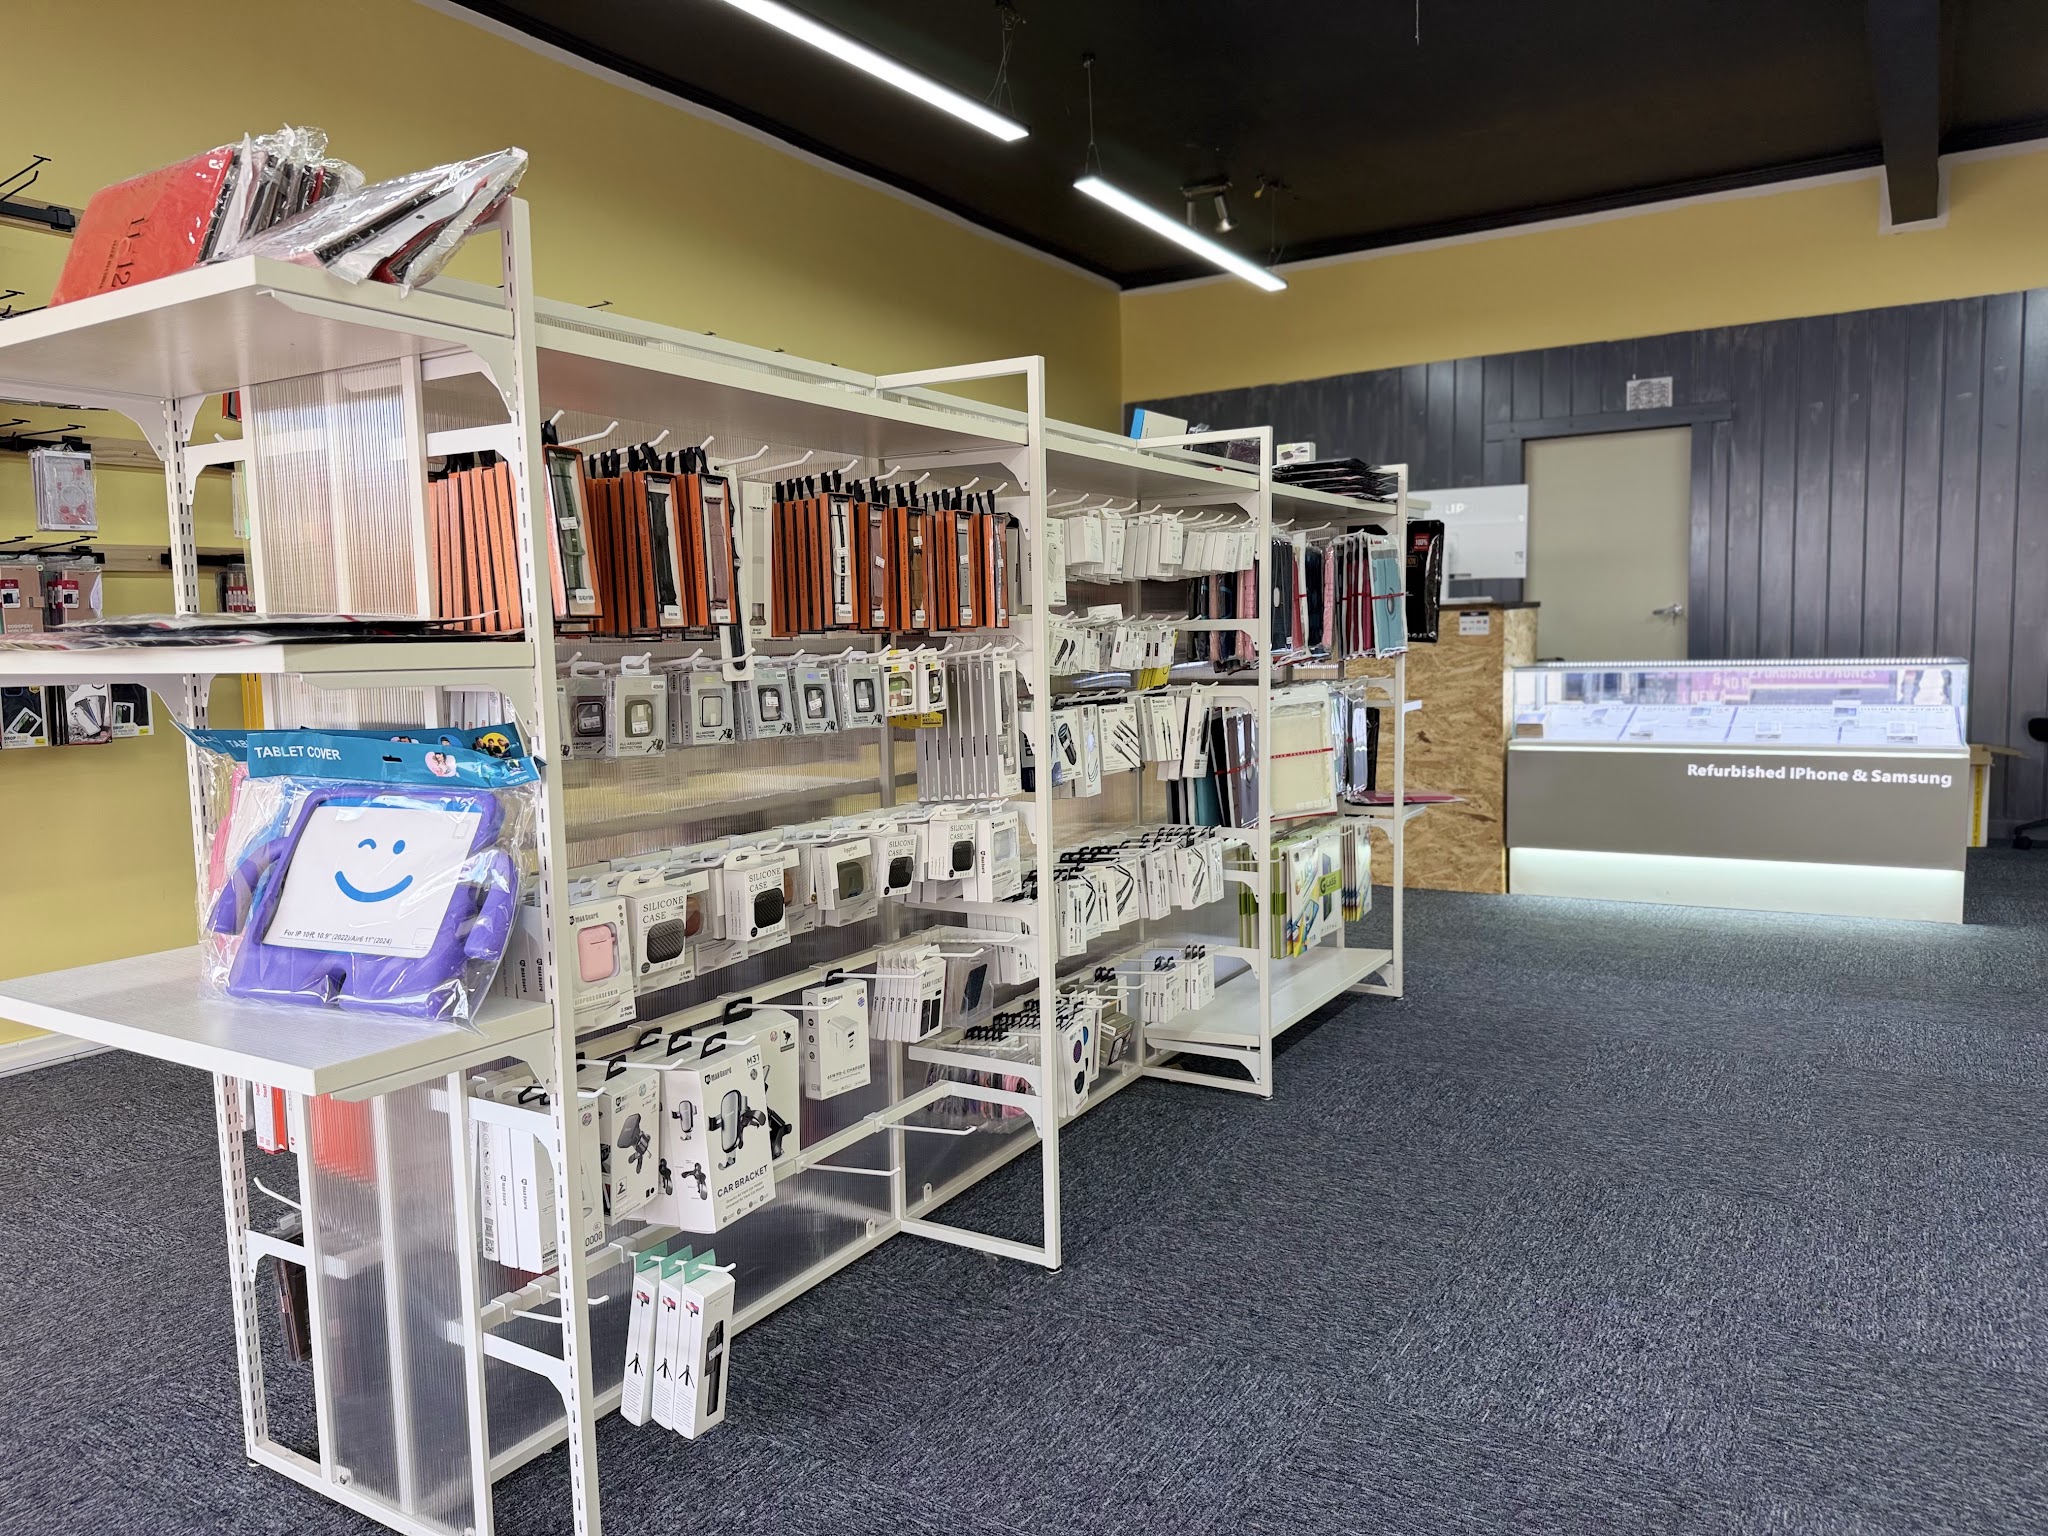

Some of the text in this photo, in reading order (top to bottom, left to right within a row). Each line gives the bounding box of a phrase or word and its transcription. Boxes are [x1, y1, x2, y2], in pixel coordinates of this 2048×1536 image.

[254, 746, 341, 761] TABLET COVER
[1687, 763, 1953, 788] Refurbished IPhone & Samsung
[950, 824, 974, 832] SILICONE
[950, 832, 963, 840] CASE
[888, 839, 914, 849] SILICONE
[888, 849, 903, 857] CASE
[749, 868, 781, 883] SILICONE
[749, 881, 768, 893] CASE
[643, 896, 684, 913] SILICONE
[642, 911, 667, 924] CASE
[746, 1053, 760, 1066] M31
[717, 1164, 768, 1198] CAR BRACKET
